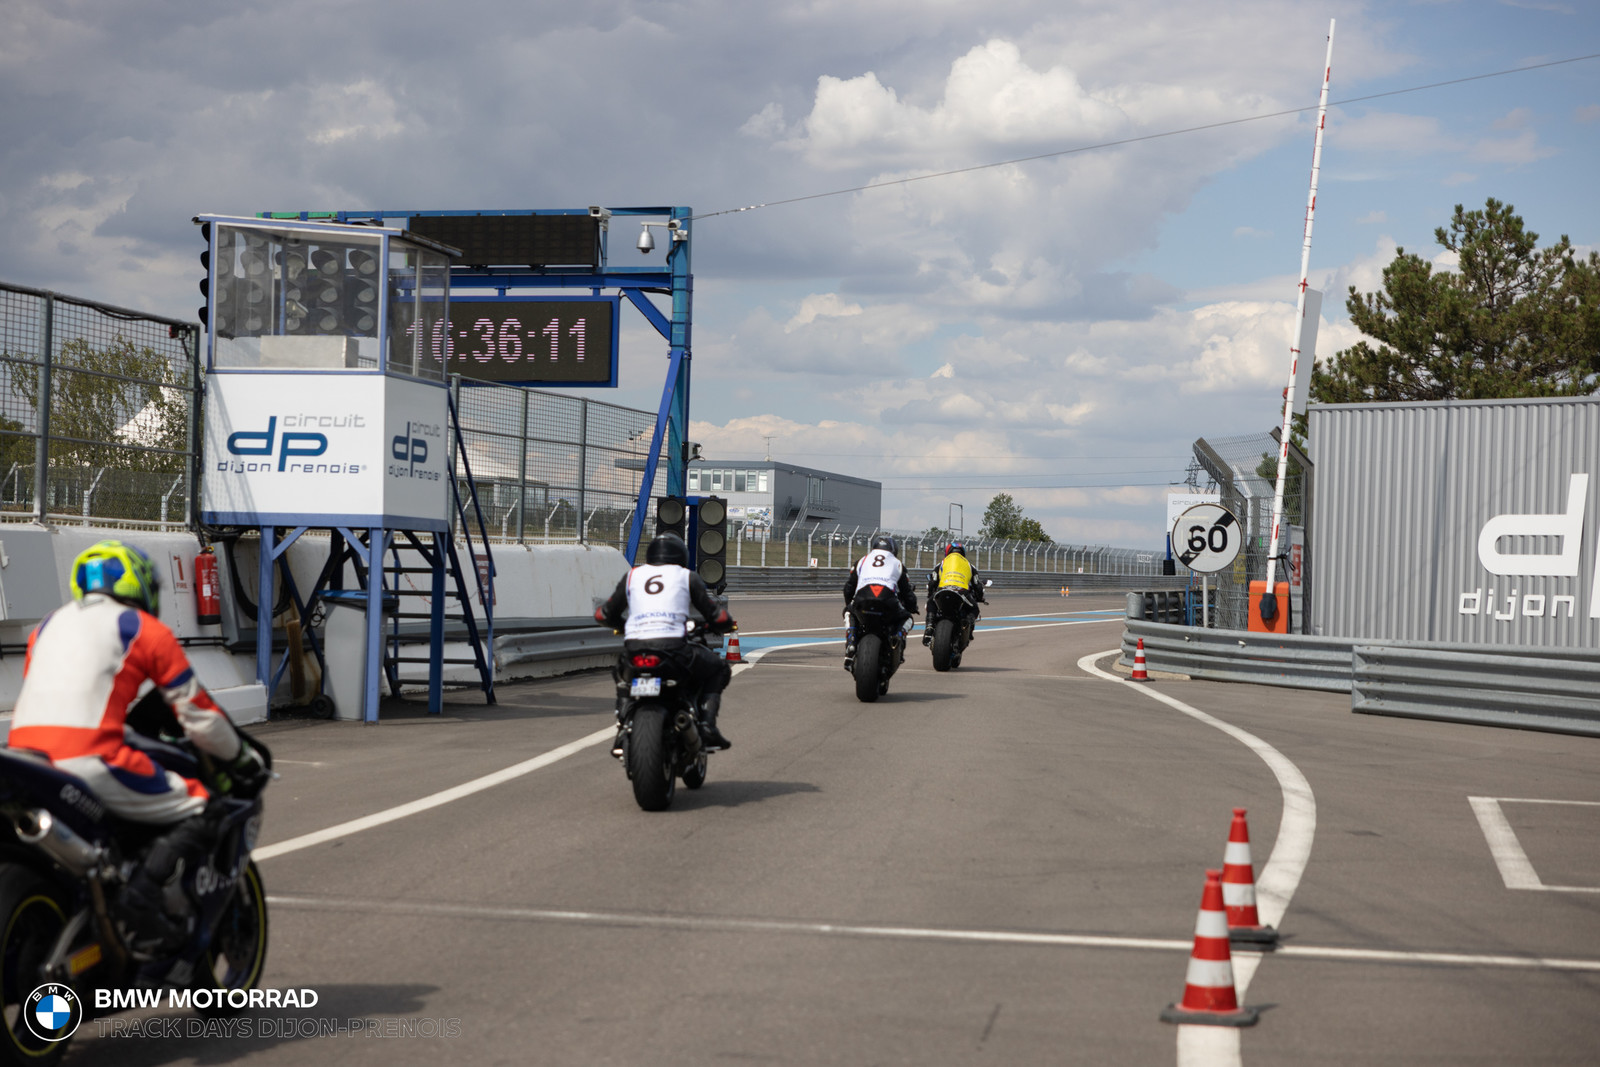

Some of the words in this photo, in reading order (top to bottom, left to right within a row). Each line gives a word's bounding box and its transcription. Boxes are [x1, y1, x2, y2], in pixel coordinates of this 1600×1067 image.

[406, 318, 586, 363] 16:36:11
[283, 413, 366, 428] circuit
[411, 421, 441, 438] circuit
[217, 460, 271, 474] dijon
[388, 464, 409, 479] dijon
[1187, 525, 1228, 553] 60
[872, 554, 885, 568] 8
[644, 574, 664, 595] 6
[1458, 587, 1575, 621] dijon
